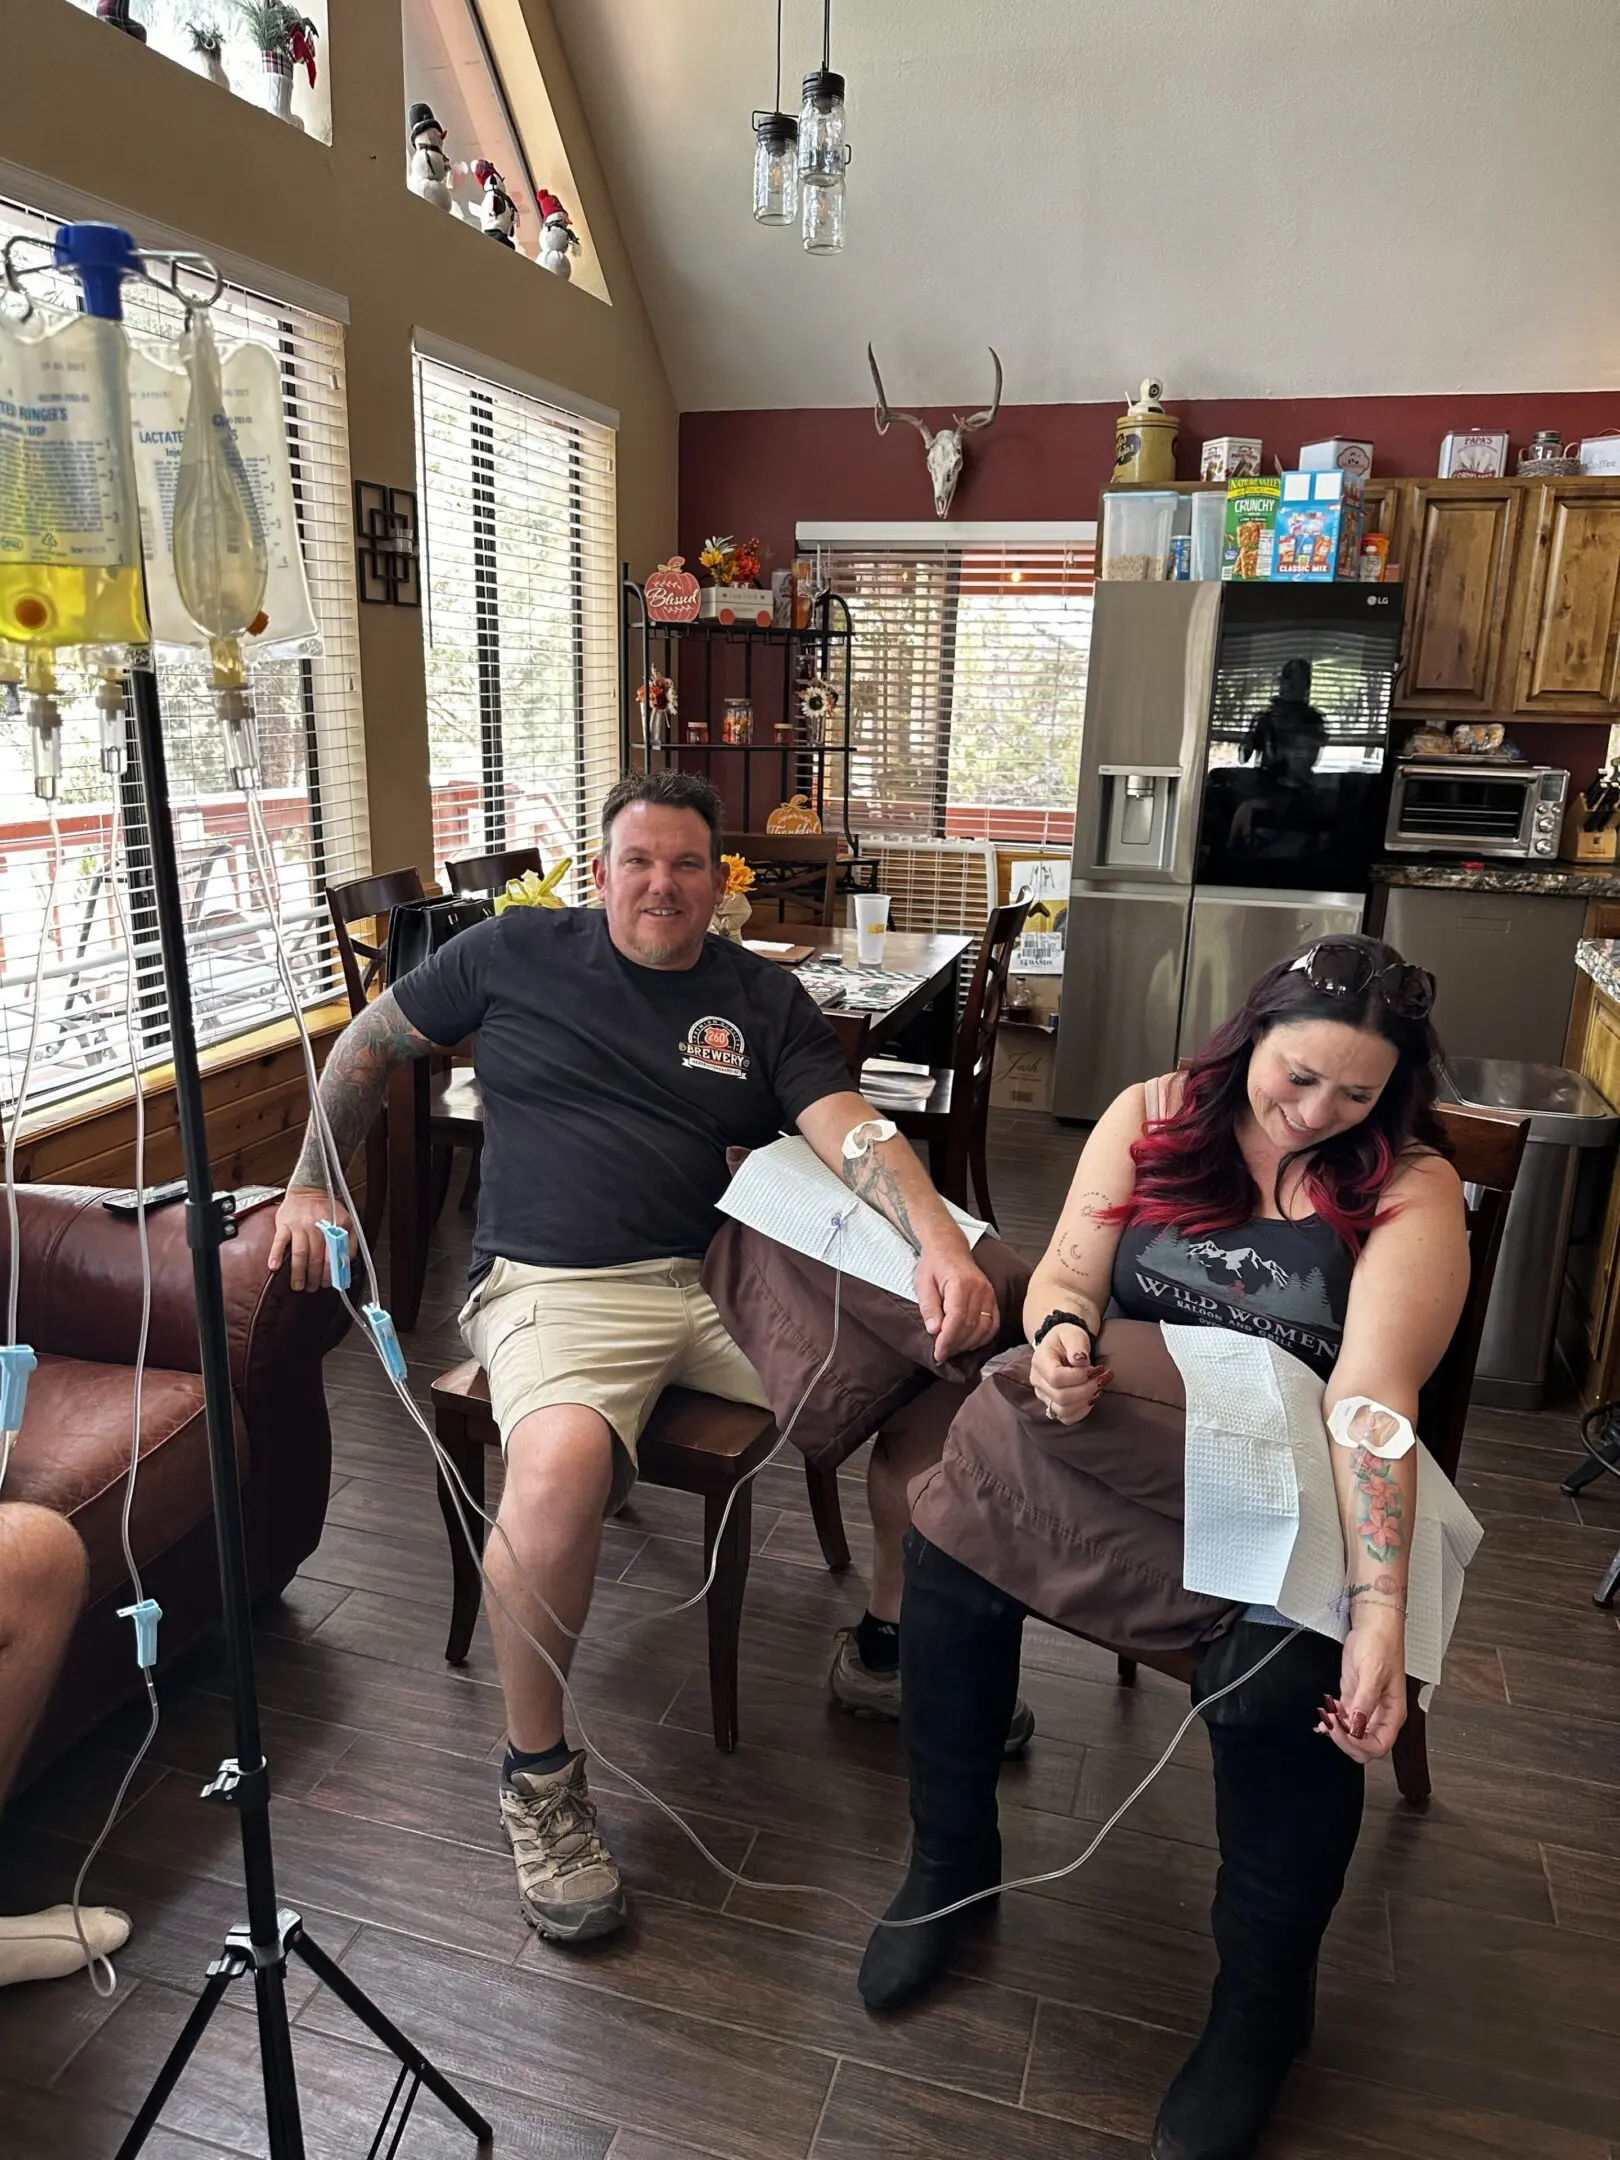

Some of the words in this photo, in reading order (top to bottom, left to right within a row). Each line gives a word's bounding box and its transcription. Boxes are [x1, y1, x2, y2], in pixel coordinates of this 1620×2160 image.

[19, 405, 68, 422] RINGER'S
[1464, 436, 1493, 446] PAPA'S
[1585, 459, 1616, 470] Coffee
[1234, 498, 1275, 513] CRUNCHY
[1279, 564, 1310, 573] CLASSIC
[1311, 564, 1328, 572] MIX
[646, 587, 699, 608] Blessed
[708, 1030, 726, 1044] 260
[687, 1044, 744, 1067] BREWERY
[1135, 1271, 1218, 1311] WILD
[1226, 1304, 1340, 1360] WOMEN
[1176, 1300, 1223, 1322] SALOON
[1228, 1319, 1253, 1332] AND
